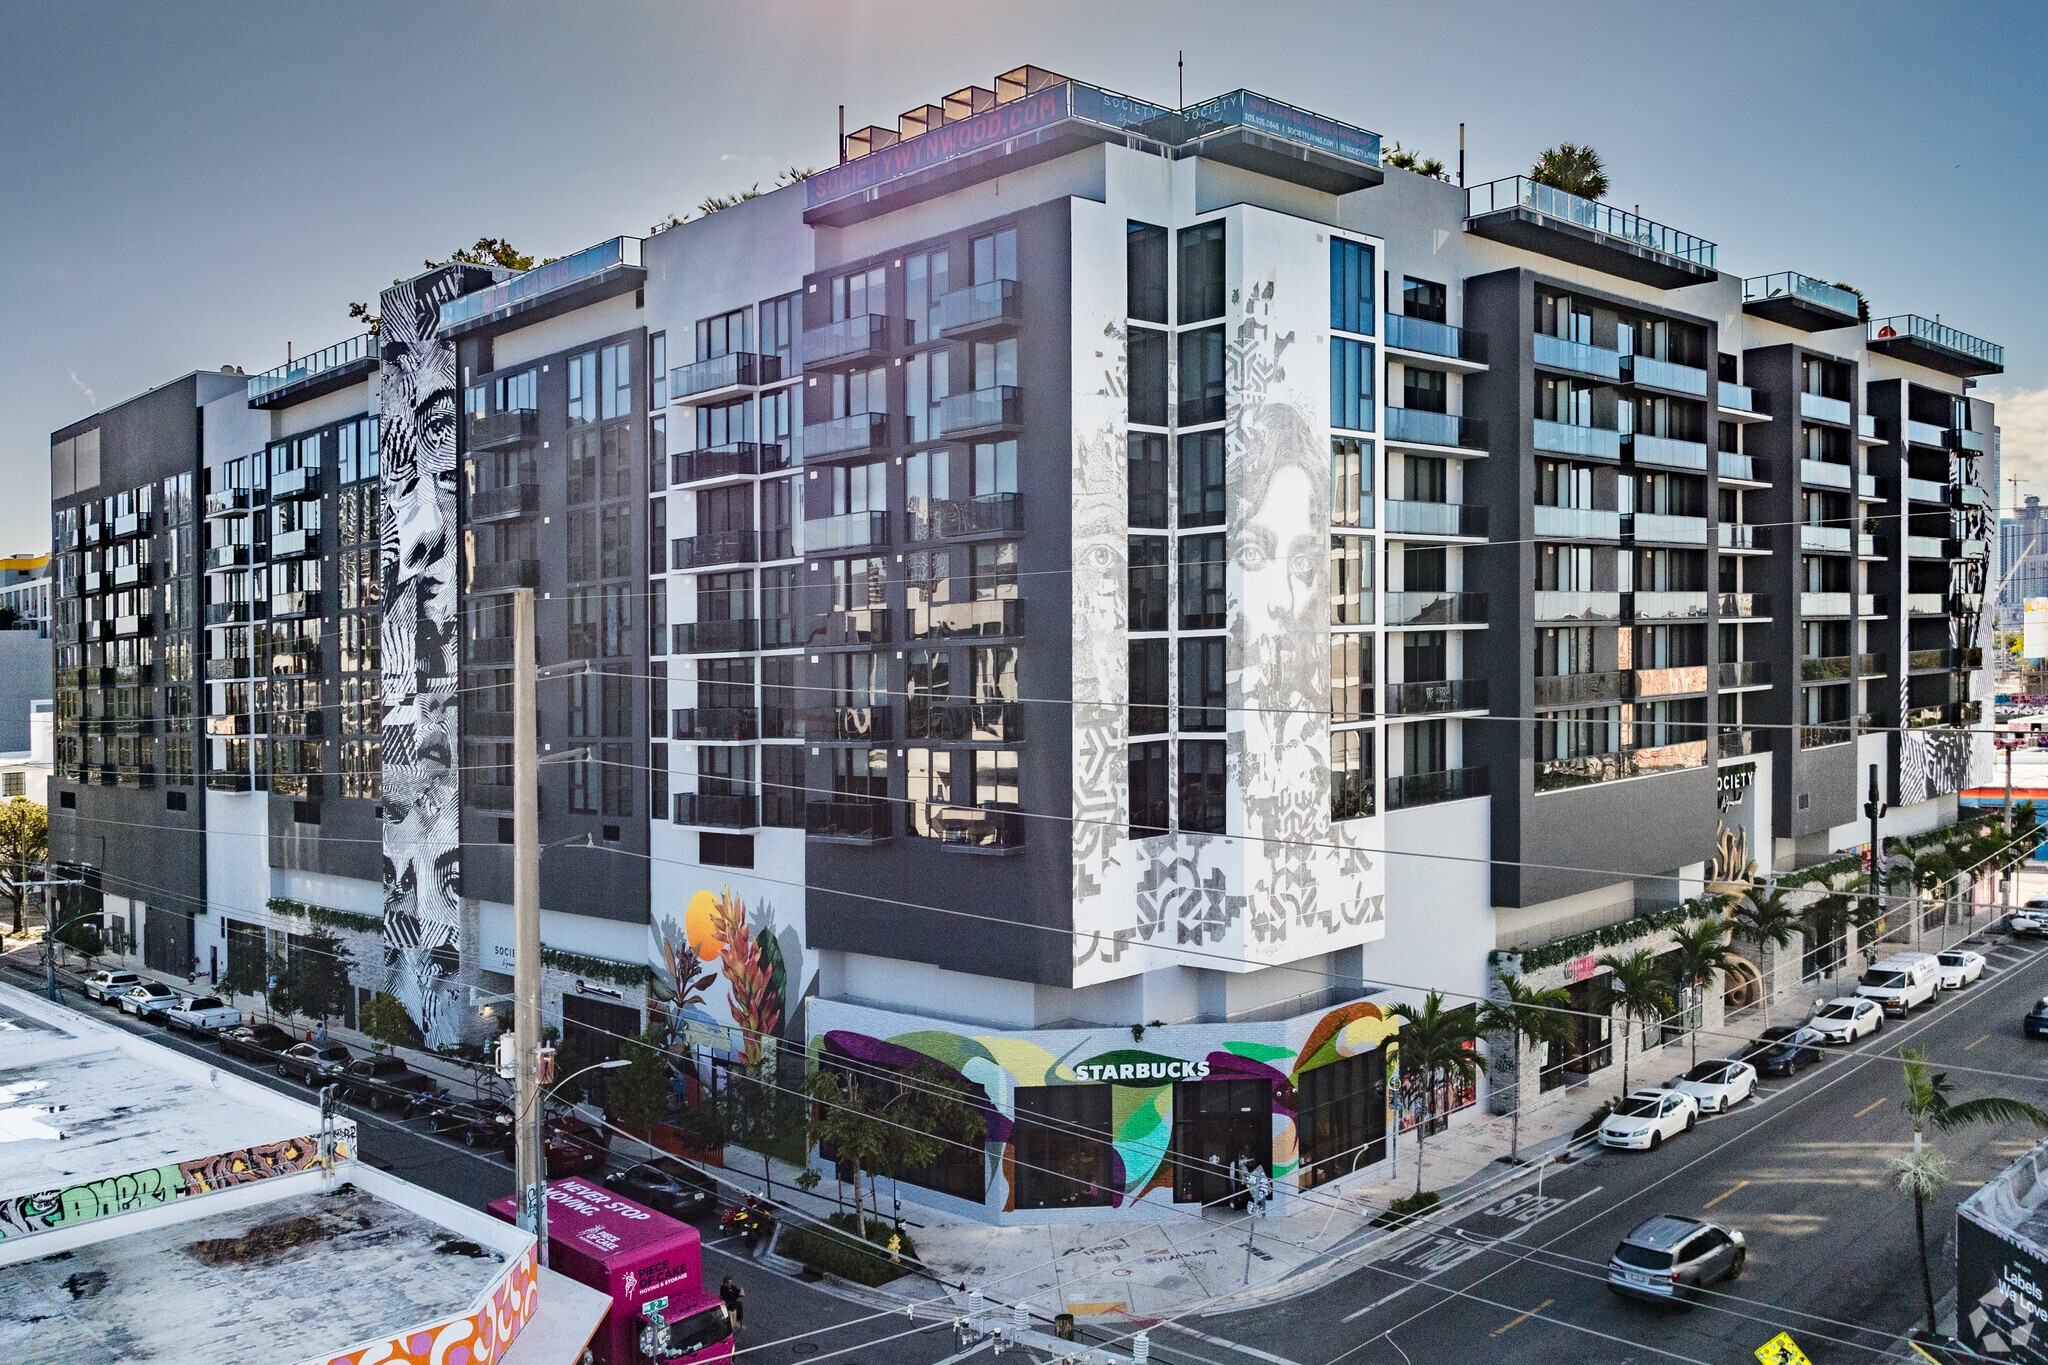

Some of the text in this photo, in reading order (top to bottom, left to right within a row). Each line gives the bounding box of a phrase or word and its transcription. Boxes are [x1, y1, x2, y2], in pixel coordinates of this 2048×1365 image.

[1103, 95, 1158, 120] SOCIETY
[1183, 95, 1237, 122] SOCIETY
[1249, 98, 1268, 113] NOW
[815, 92, 1056, 199] SOCIETYWYNWOOD.COM
[1717, 771, 1754, 791] OCIETY
[494, 945, 515, 957] SOCIE
[1076, 1061, 1210, 1081] STARBUCKS
[558, 1181, 612, 1204] NEVER
[604, 1201, 651, 1220] STOP
[1484, 1193, 1565, 1222] BUS
[1381, 1236, 1481, 1271] ONLY
[638, 1260, 669, 1278] PIECE
[640, 1263, 687, 1289] OF CAKE
[2004, 1264, 2042, 1300] Labels
[639, 1283, 660, 1295] MOVING
[664, 1272, 688, 1286] STORAGE
[1999, 1278, 2017, 1303] We
[2020, 1292, 2048, 1322] Love
